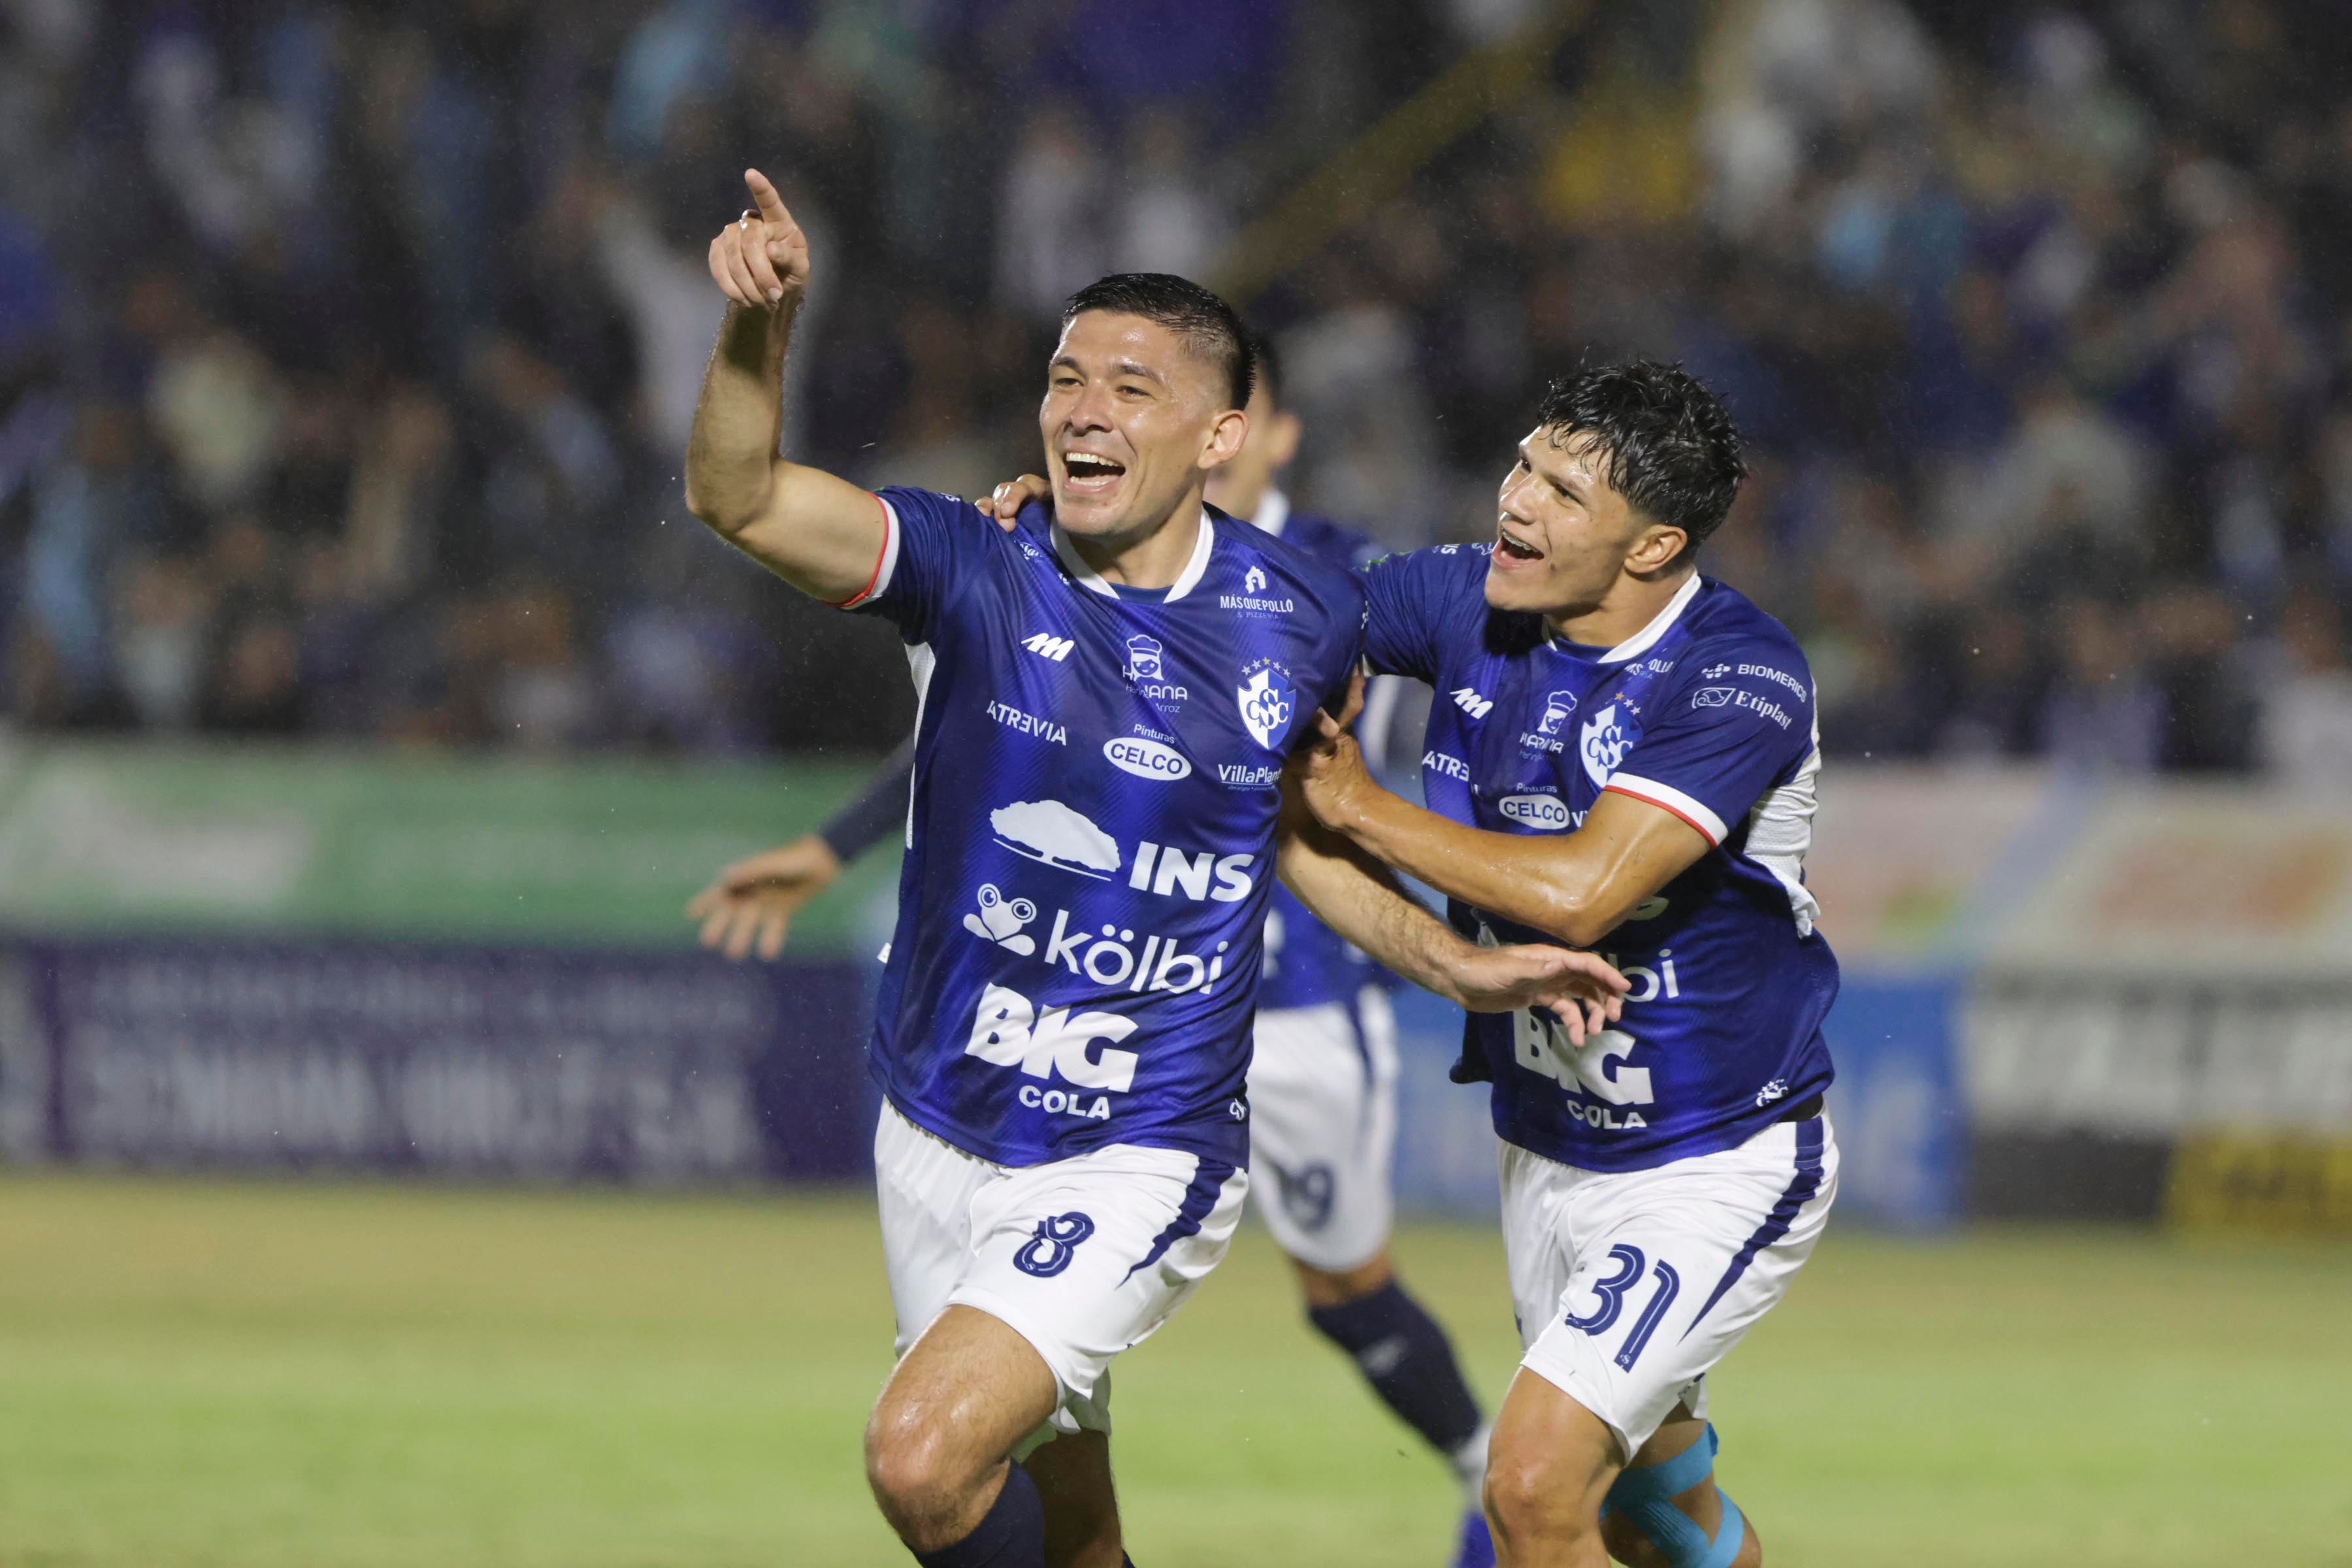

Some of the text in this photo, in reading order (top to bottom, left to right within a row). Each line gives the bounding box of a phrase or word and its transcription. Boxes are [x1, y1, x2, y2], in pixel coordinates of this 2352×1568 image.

[1737, 664, 1808, 703] BIOMERICS
[987, 700, 1067, 746] ATREVIA
[1735, 691, 1793, 730] Etiplast
[1134, 723, 1175, 744] Pinturas
[1111, 743, 1183, 774] CELCO
[1422, 750, 1478, 794] ATRE
[1516, 782, 1558, 793] Pinturas
[1503, 801, 1565, 823] CELCO
[1129, 841, 1254, 902] INS
[1044, 909, 1228, 994] kölbi
[964, 982, 1139, 1093] BIG
[1513, 1006, 1654, 1105] BIG
[1019, 1085, 1111, 1120] COLA
[1567, 1099, 1648, 1130] COLA
[1013, 1211, 1095, 1278] 8
[1565, 1243, 1680, 1374] 31
